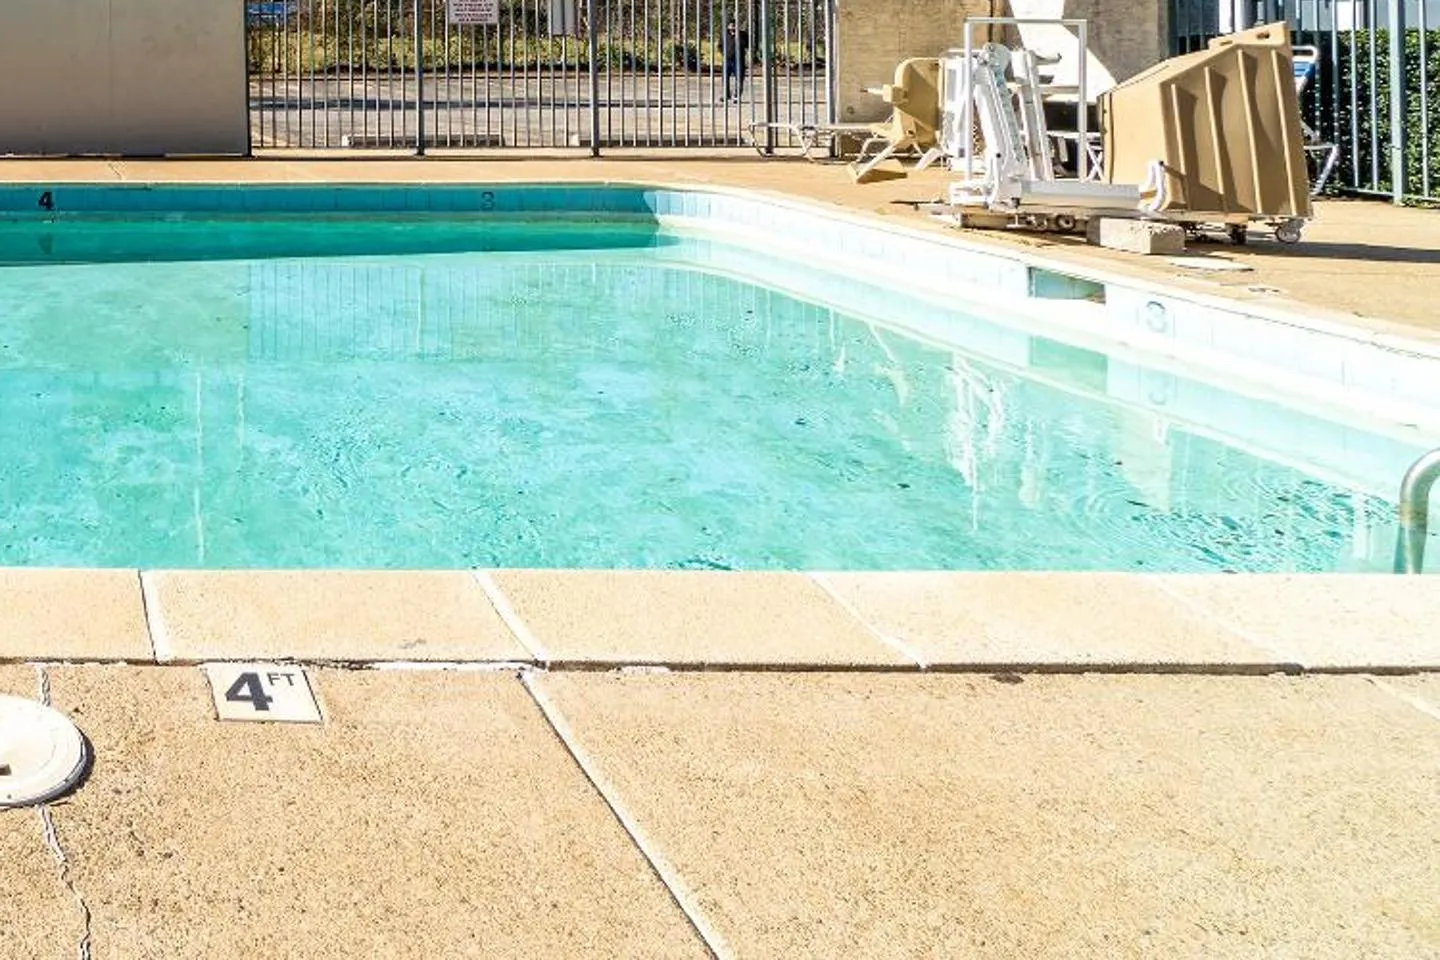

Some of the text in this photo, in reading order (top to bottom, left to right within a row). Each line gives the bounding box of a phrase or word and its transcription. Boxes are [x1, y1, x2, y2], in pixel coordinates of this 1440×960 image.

[38, 191, 55, 211] 4
[224, 672, 295, 711] 4 FT
